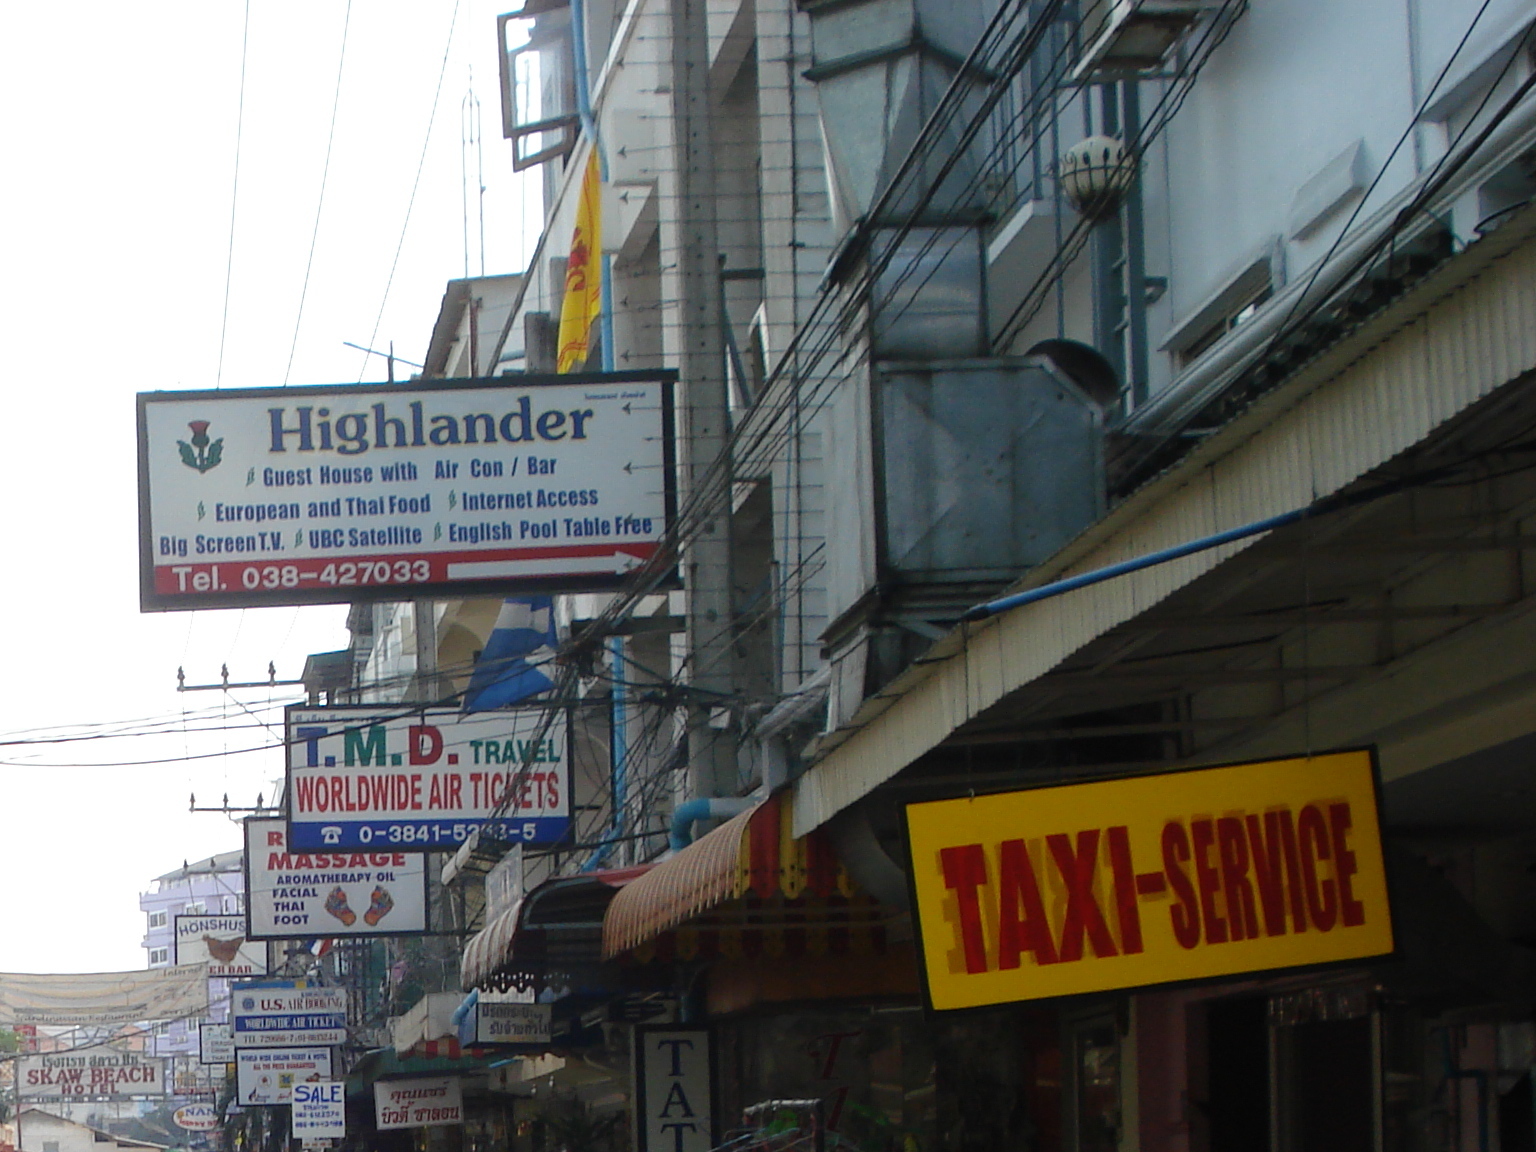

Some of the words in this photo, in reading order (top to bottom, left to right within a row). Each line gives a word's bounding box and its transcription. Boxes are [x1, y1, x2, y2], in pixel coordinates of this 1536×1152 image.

[268, 396, 593, 456] Highlander
[264, 467, 312, 487] Guest
[320, 466, 373, 485] House
[381, 461, 417, 481] with
[435, 460, 458, 479] Air
[471, 458, 503, 478] Con
[511, 457, 519, 477] /
[527, 456, 557, 476] Bar
[216, 502, 300, 523] European
[308, 500, 340, 518] and
[345, 497, 384, 516] Thai
[388, 494, 431, 515] Food
[462, 490, 532, 511] Internet
[537, 489, 599, 508] Access
[160, 535, 188, 557] Big
[195, 533, 255, 554] Screen
[258, 531, 285, 551] T.V.
[308, 528, 344, 549] UBC
[352, 525, 422, 546] Satellite
[449, 522, 512, 544] English
[520, 520, 557, 540] Pool
[563, 517, 610, 537] Table
[615, 515, 652, 535] Free
[172, 566, 227, 591] Tel.
[242, 560, 431, 590] 038-427033
[296, 725, 459, 767] T.M.D.
[469, 739, 561, 765] TRAVEL
[296, 774, 422, 813] WORLDWIDE
[428, 773, 462, 810] AIR
[267, 852, 406, 870] MASSAGE
[277, 872, 371, 885] AROMATHERAPY
[377, 872, 395, 882] OIL
[272, 888, 318, 899] FACIAL
[939, 802, 1366, 976] TAXI-SERVICE
[273, 901, 305, 912] THAI
[273, 915, 309, 926] FOOT
[228, 965, 252, 975] BAR
[261, 998, 285, 1010] U.S.
[244, 1018, 290, 1030] WORLDWIDE
[292, 1017, 308, 1029] AIR
[310, 1015, 335, 1028] TICKET
[27, 1066, 86, 1085] SKAW
[91, 1066, 156, 1084] BEACH
[62, 1084, 119, 1095] HOTEL
[294, 1085, 342, 1104] SALE
